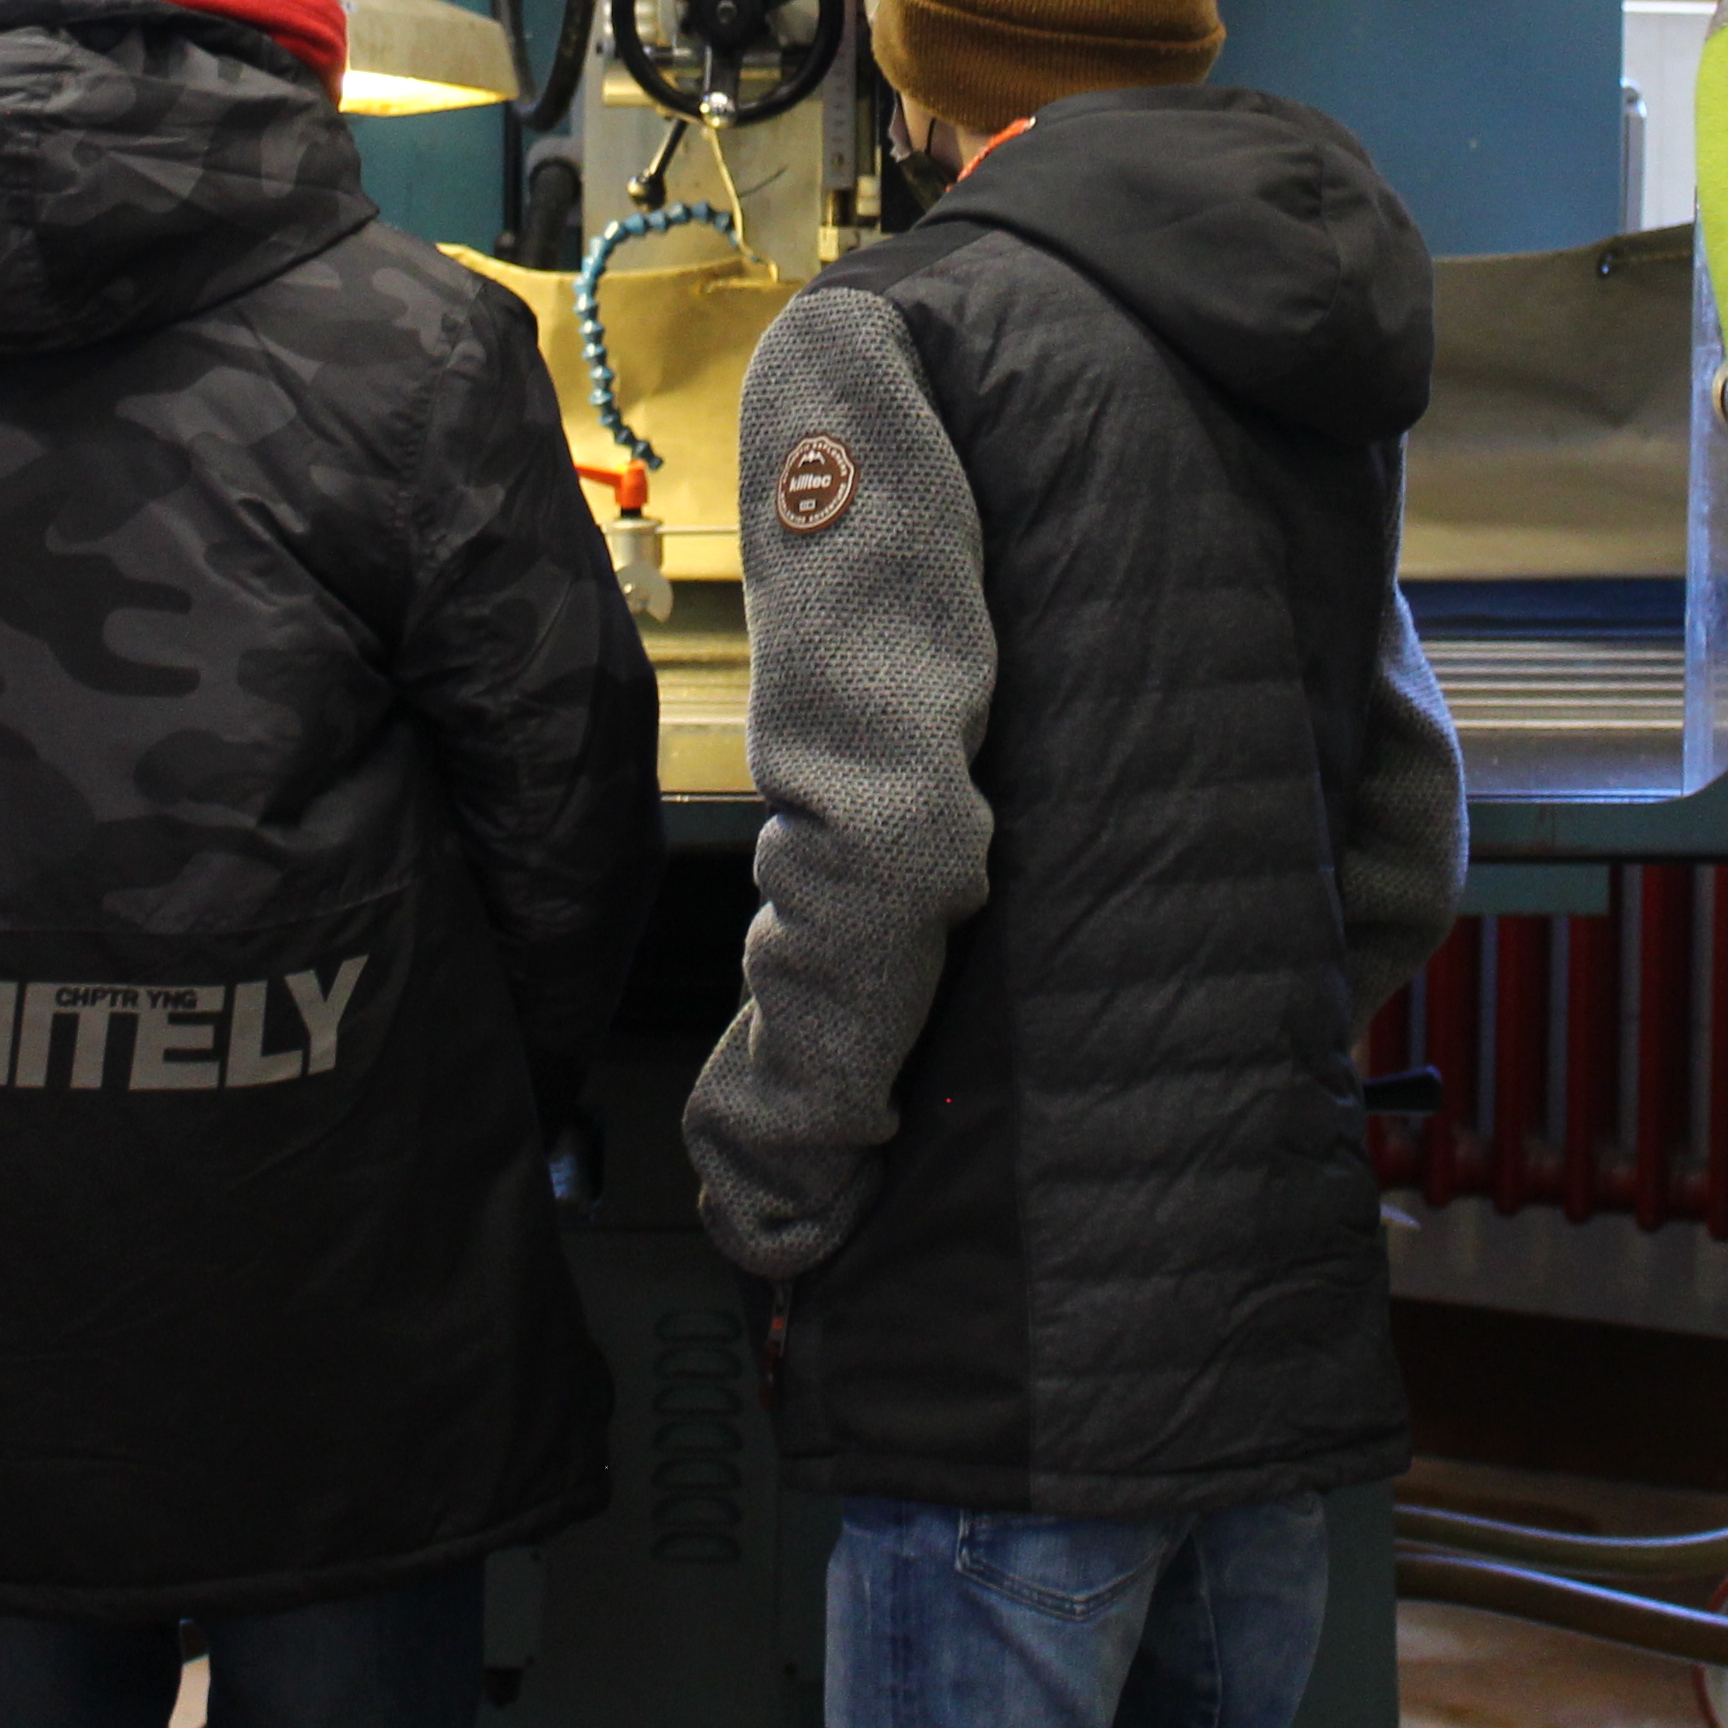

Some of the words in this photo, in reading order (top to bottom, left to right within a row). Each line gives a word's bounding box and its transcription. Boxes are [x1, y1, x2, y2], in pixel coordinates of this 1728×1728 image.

[788, 473, 833, 493] killtec
[55, 986, 139, 1008] CHPTR
[147, 988, 198, 1010] YNG
